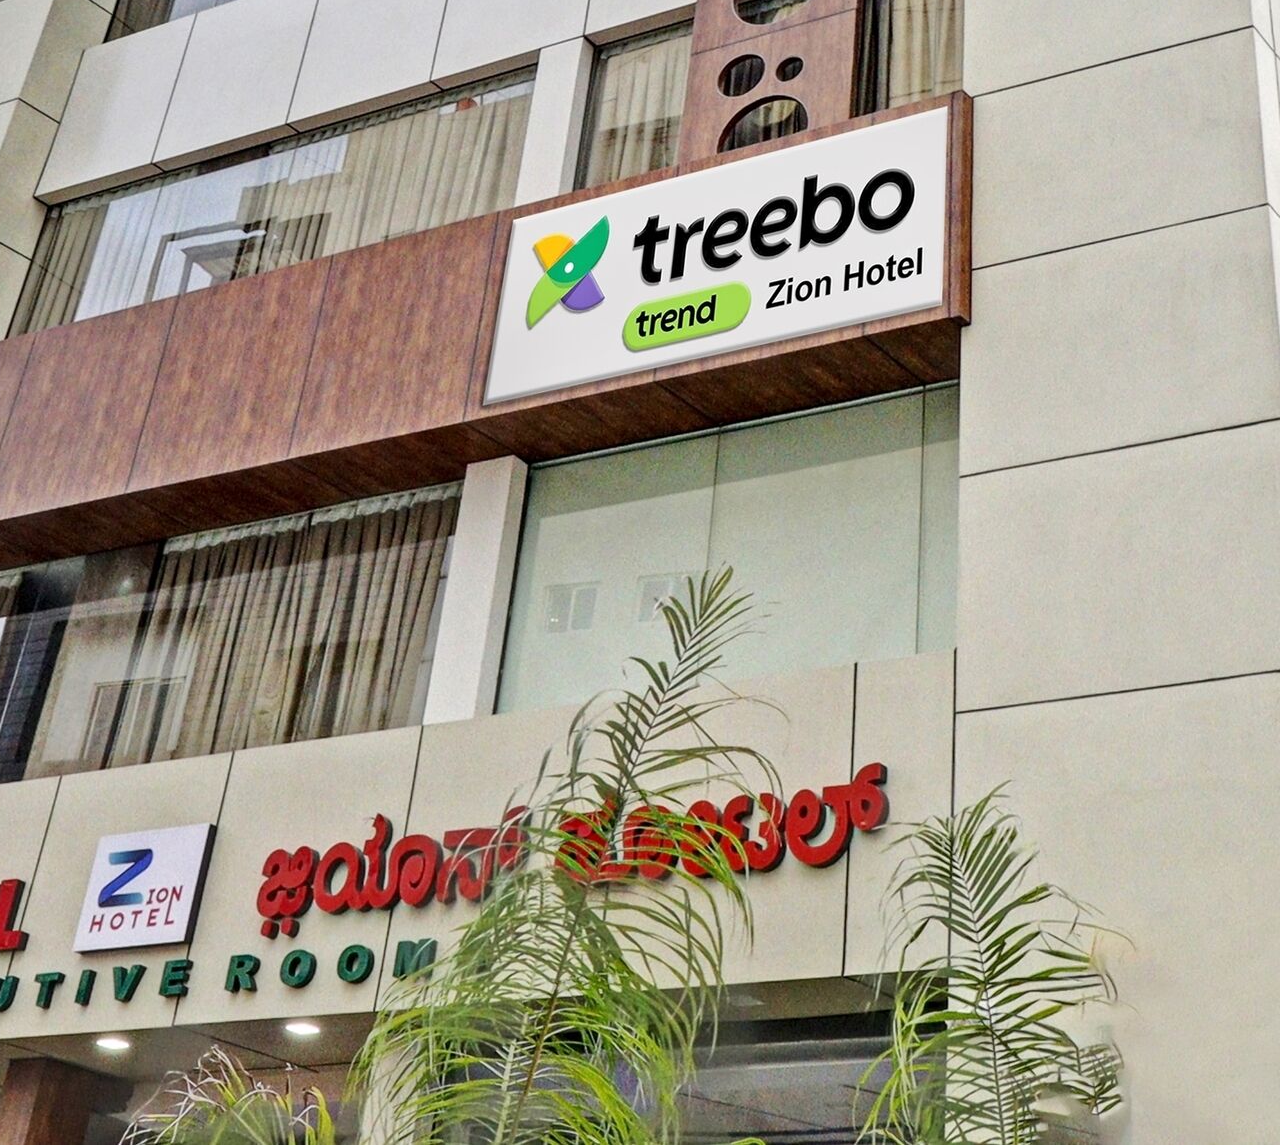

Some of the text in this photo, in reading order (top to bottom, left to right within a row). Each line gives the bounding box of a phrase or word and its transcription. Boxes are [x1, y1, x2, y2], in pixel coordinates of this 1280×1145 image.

[633, 167, 916, 286] treebo
[765, 248, 924, 310] Zion Hotel
[635, 295, 717, 338] trend
[88, 905, 176, 934] HOTEL
[224, 937, 496, 993] ROOM
